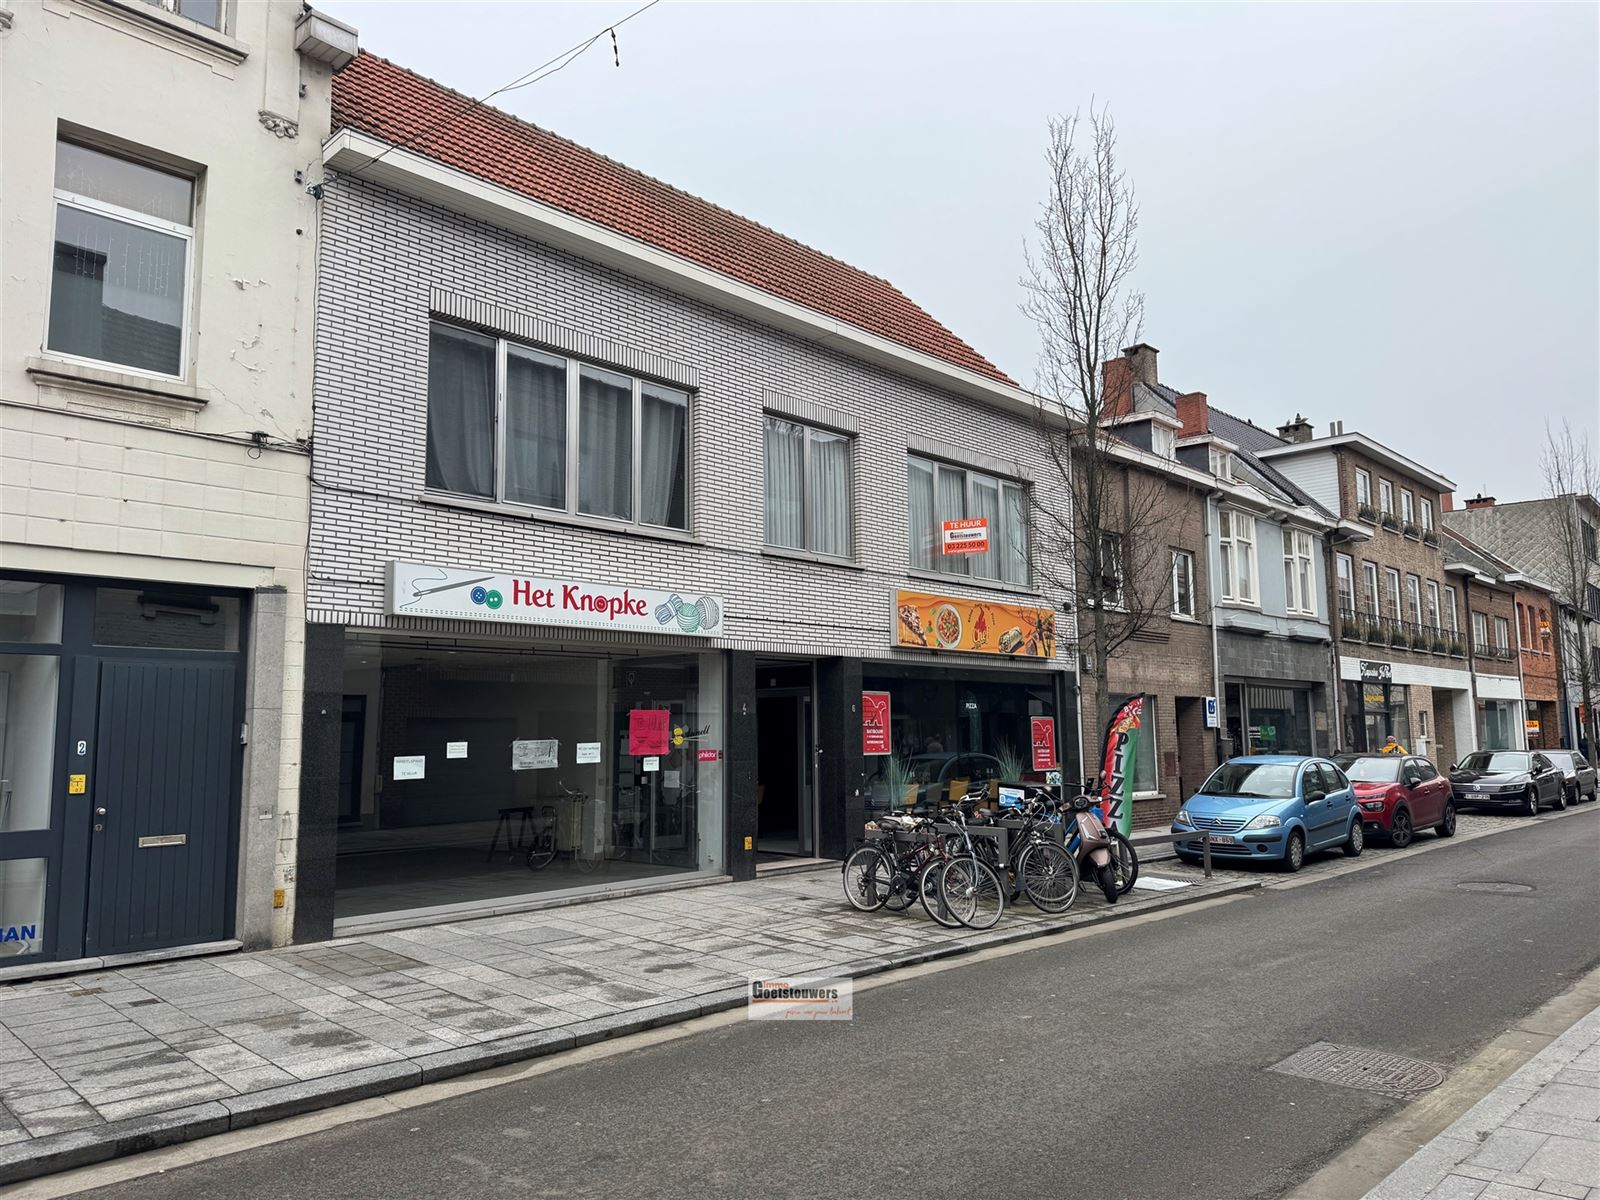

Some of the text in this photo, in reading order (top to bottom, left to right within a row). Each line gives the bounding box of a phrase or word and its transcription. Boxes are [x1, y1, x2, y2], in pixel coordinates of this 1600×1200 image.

[960, 520, 982, 528] HUUR
[512, 579, 649, 621] Het Knopke
[79, 742, 84, 753] 2
